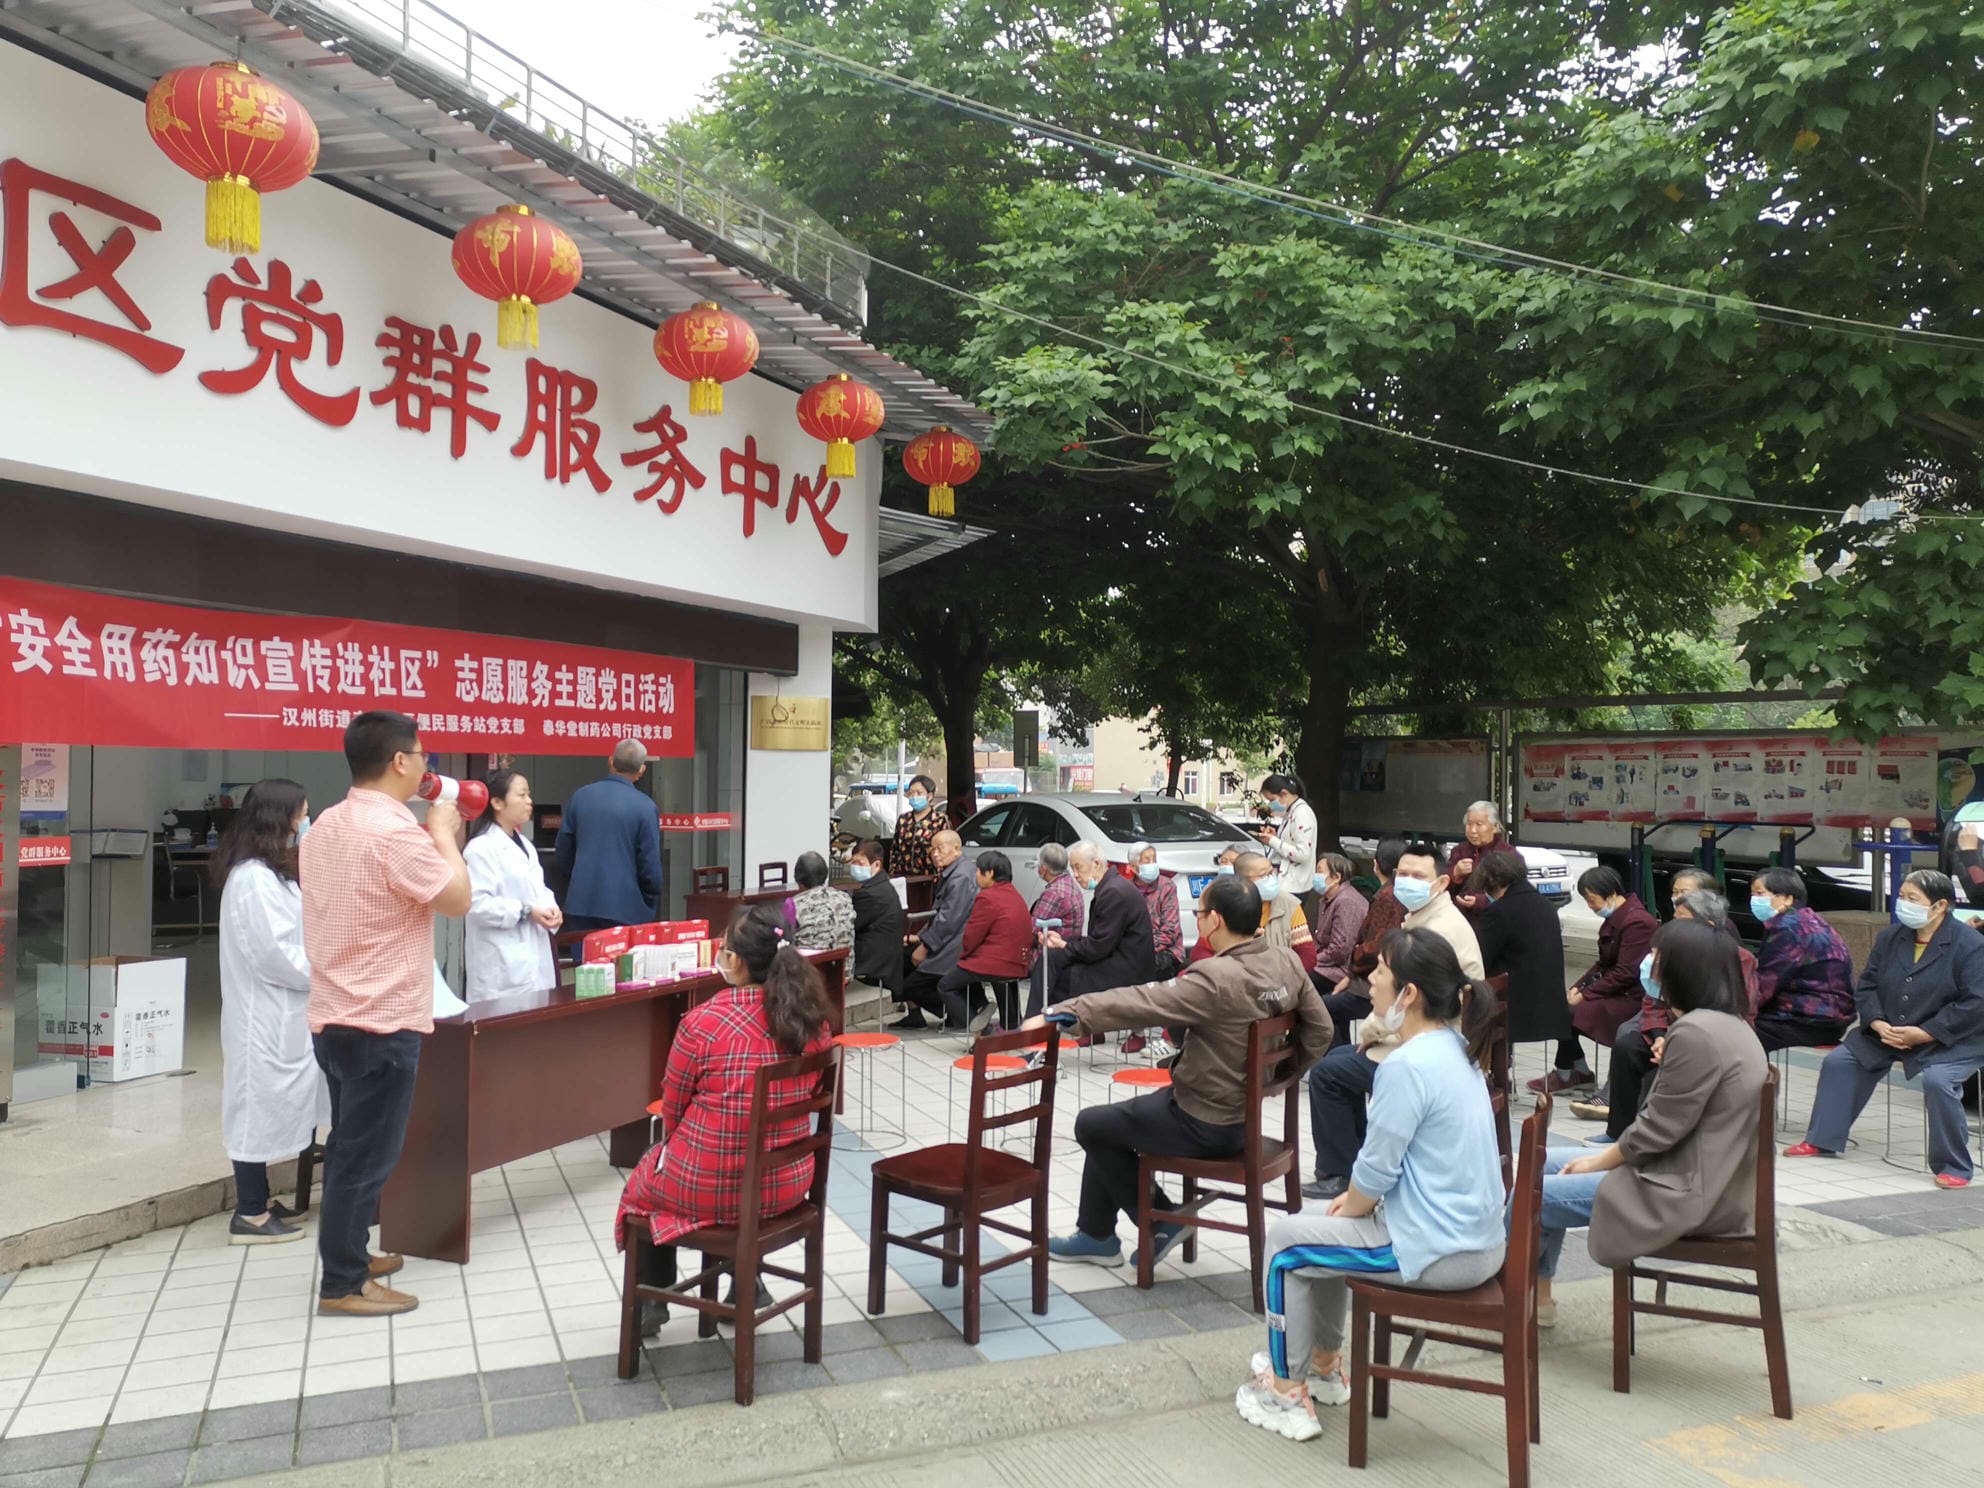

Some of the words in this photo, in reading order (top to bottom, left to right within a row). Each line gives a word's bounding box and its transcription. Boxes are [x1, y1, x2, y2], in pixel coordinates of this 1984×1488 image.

[1, 156, 849, 556] 区党群服务中心
